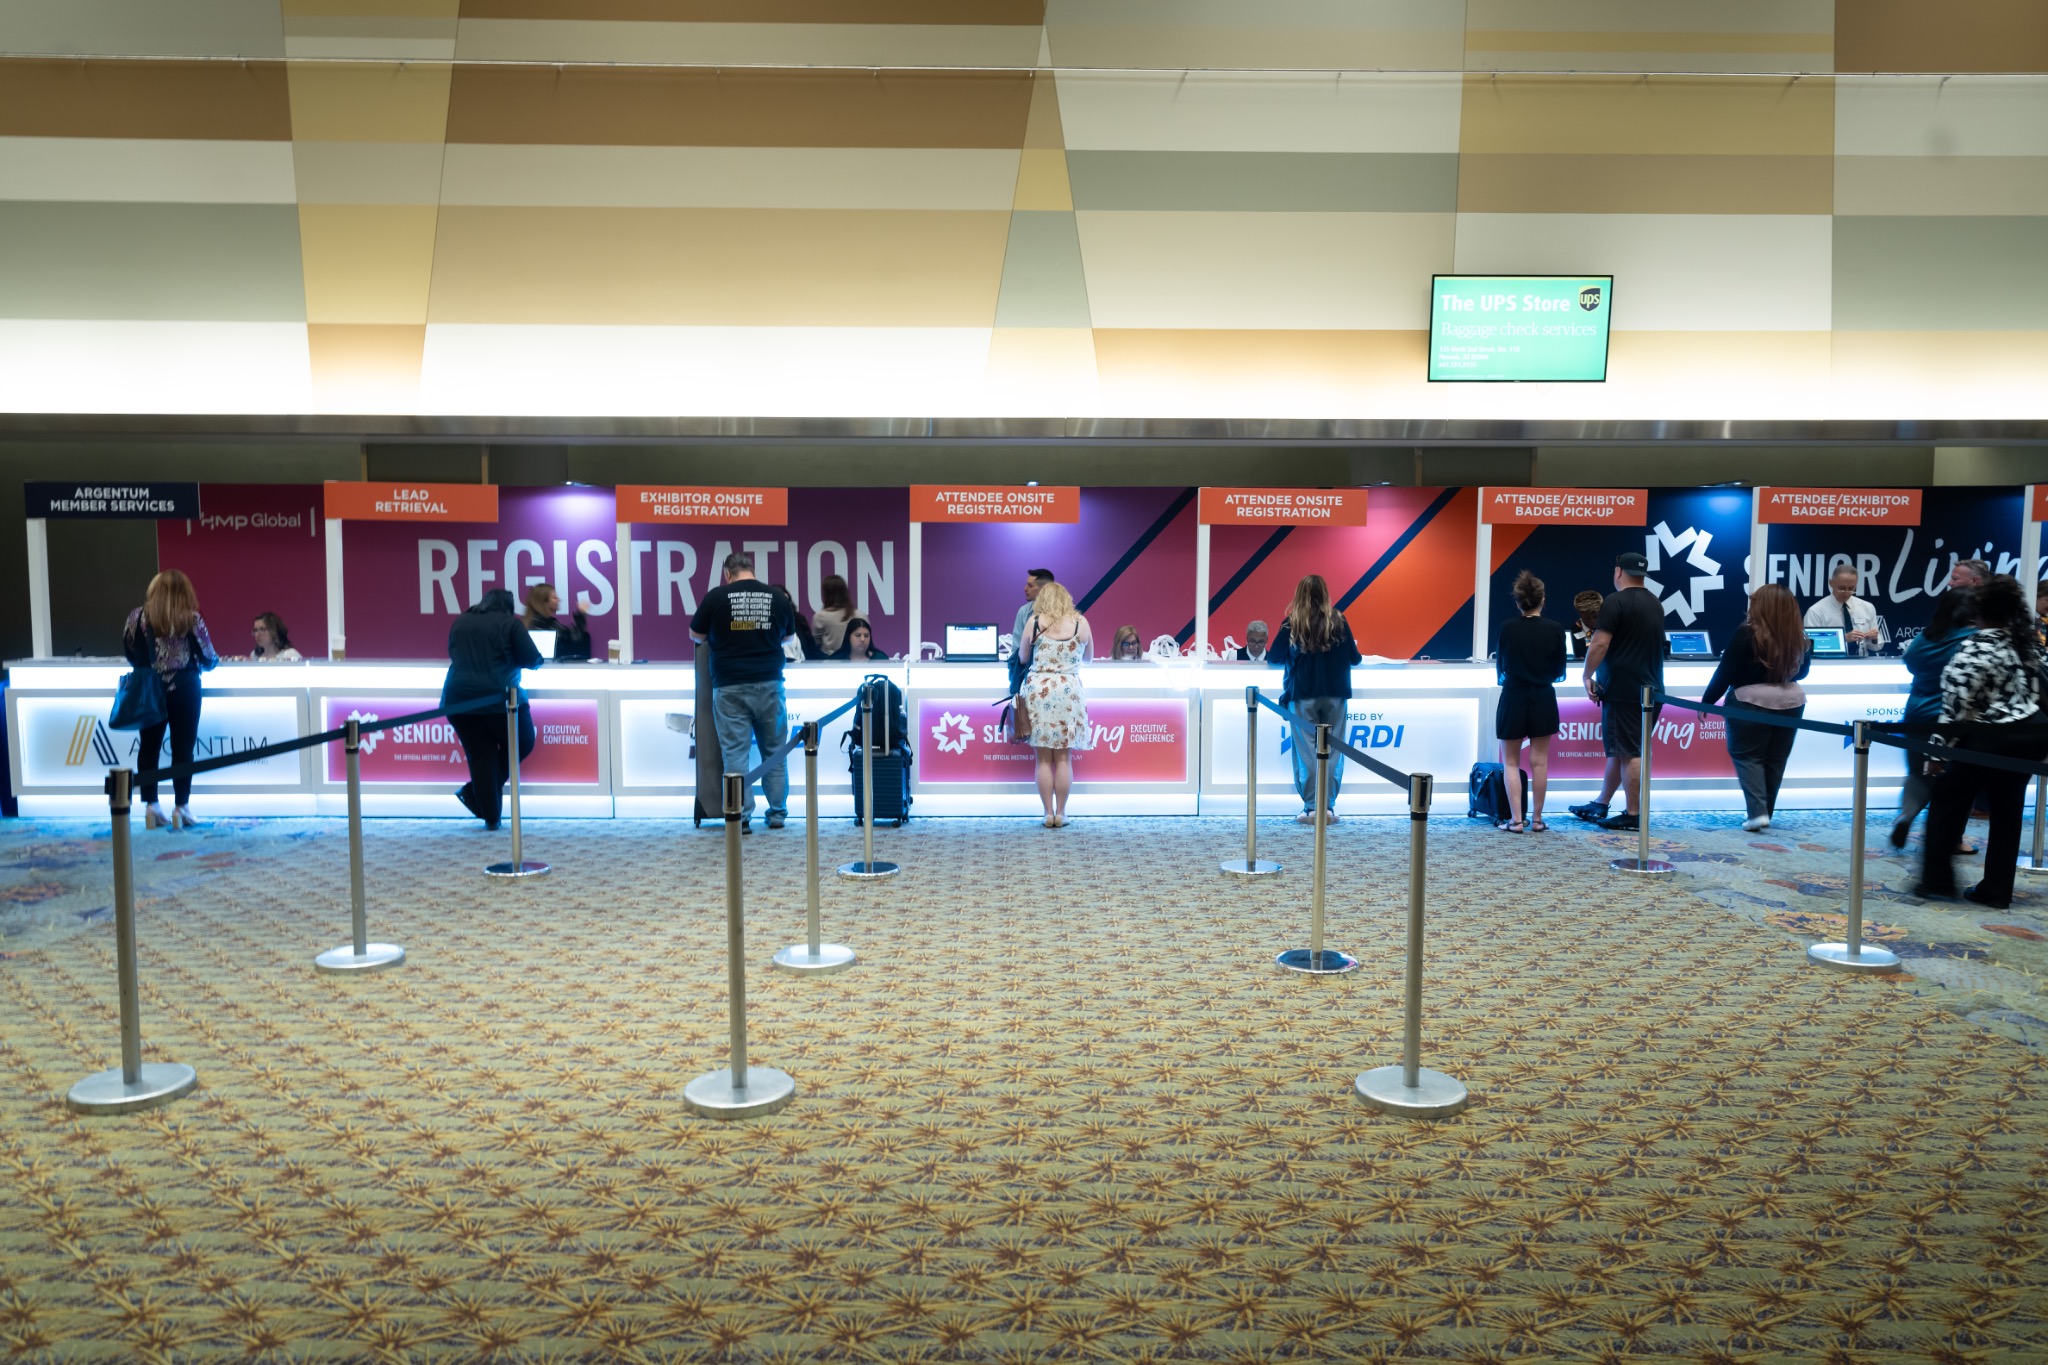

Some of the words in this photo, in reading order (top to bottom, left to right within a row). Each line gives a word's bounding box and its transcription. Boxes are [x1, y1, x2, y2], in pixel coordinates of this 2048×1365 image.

[1441, 294, 1474, 311] The
[1480, 294, 1516, 312] UPS
[1522, 295, 1570, 312] Store
[1580, 293, 1600, 308] ups
[1441, 322, 1497, 339] Baggage
[1500, 321, 1539, 336] check
[1543, 322, 1597, 336] services
[75, 487, 150, 499] ARGENTUM
[393, 489, 429, 501] LEAD
[640, 492, 711, 504] EXHIBITOR
[714, 493, 764, 505] ONSITE
[935, 491, 1003, 503] ATTENDEE
[1007, 492, 1055, 503] ONSITE
[50, 499, 107, 512] MEMBER
[110, 500, 176, 512] SERVICES
[1224, 494, 1292, 505] ATTENDEE
[1295, 495, 1343, 506] ONSITE
[1494, 493, 1635, 506] ATTENDEE/EXHIBITOR
[1771, 493, 1910, 506] ATTENDEE/EXHIBITOR
[375, 501, 449, 514] RETRIEVAL
[653, 504, 750, 517] REGISTRATION
[947, 504, 1043, 515] REGISTRATION
[1236, 506, 1331, 518] REGISTRATION
[1515, 506, 1560, 517] BADGE
[1563, 507, 1614, 517] PICK-UP
[1791, 506, 1835, 517] BADGE
[1838, 506, 1889, 517] PICK-UP
[201, 511, 248, 530] HMP
[251, 512, 301, 528] Global
[1866, 707, 1906, 716] SPONSO
[543, 724, 581, 734] EXECUTIVE
[1130, 724, 1168, 733] EXECUTIVE
[1558, 722, 1603, 741] SENIO
[1700, 721, 1726, 730] EXECUT
[392, 723, 455, 744] SENIOR
[543, 735, 589, 744] CONFERENCE
[1130, 733, 1175, 743] CONFERENCE
[1348, 724, 1405, 748] RDI
[1699, 731, 1726, 740] CONFER
